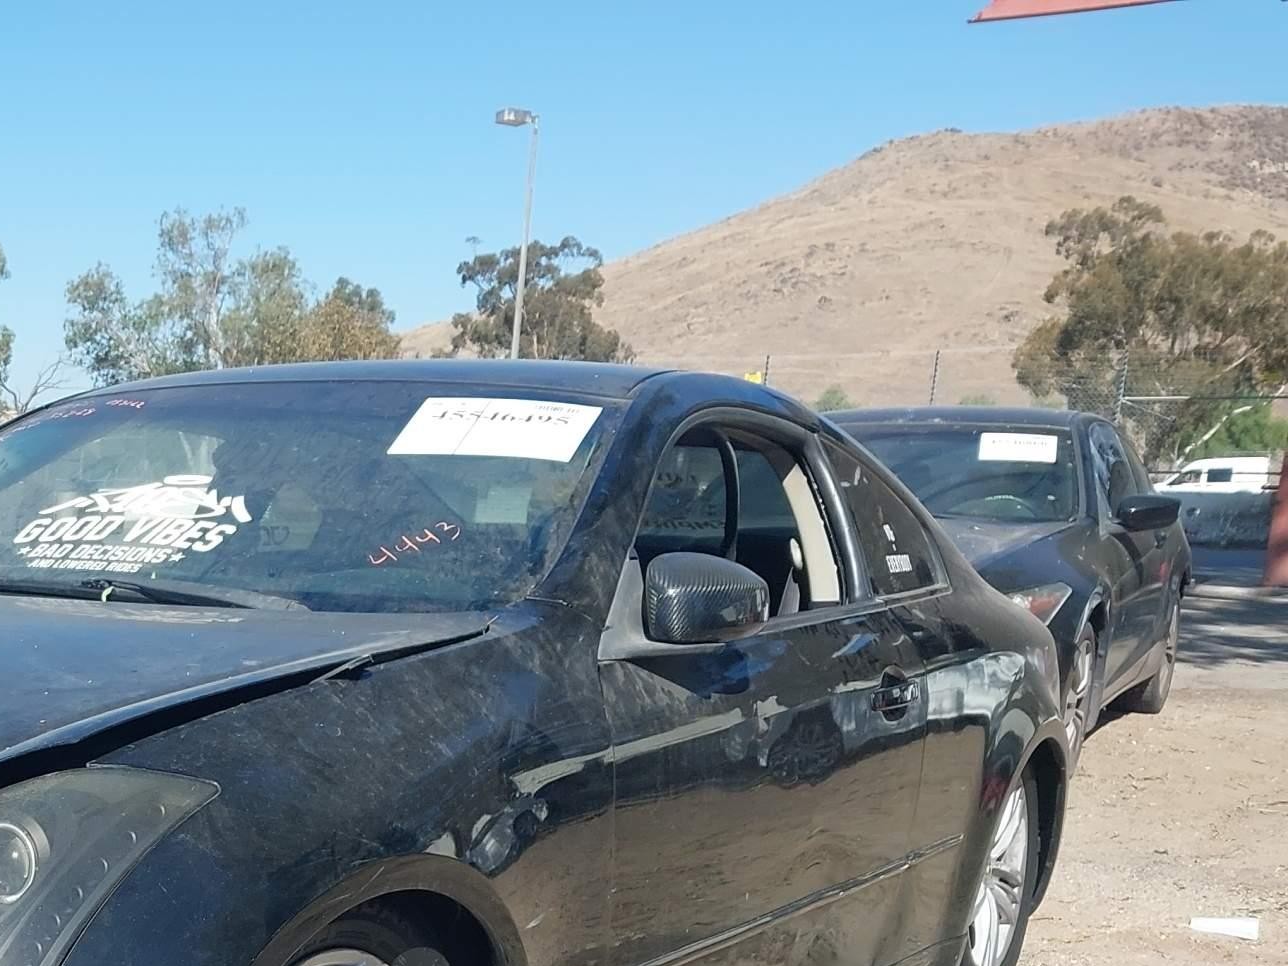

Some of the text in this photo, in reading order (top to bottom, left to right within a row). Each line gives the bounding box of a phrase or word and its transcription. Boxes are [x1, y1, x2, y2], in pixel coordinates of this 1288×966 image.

[14, 515, 237, 552] GOOD VIBES
[27, 543, 173, 564] BAD DECISIONS
[27, 558, 56, 568] AND
[52, 559, 109, 571] LOWERED
